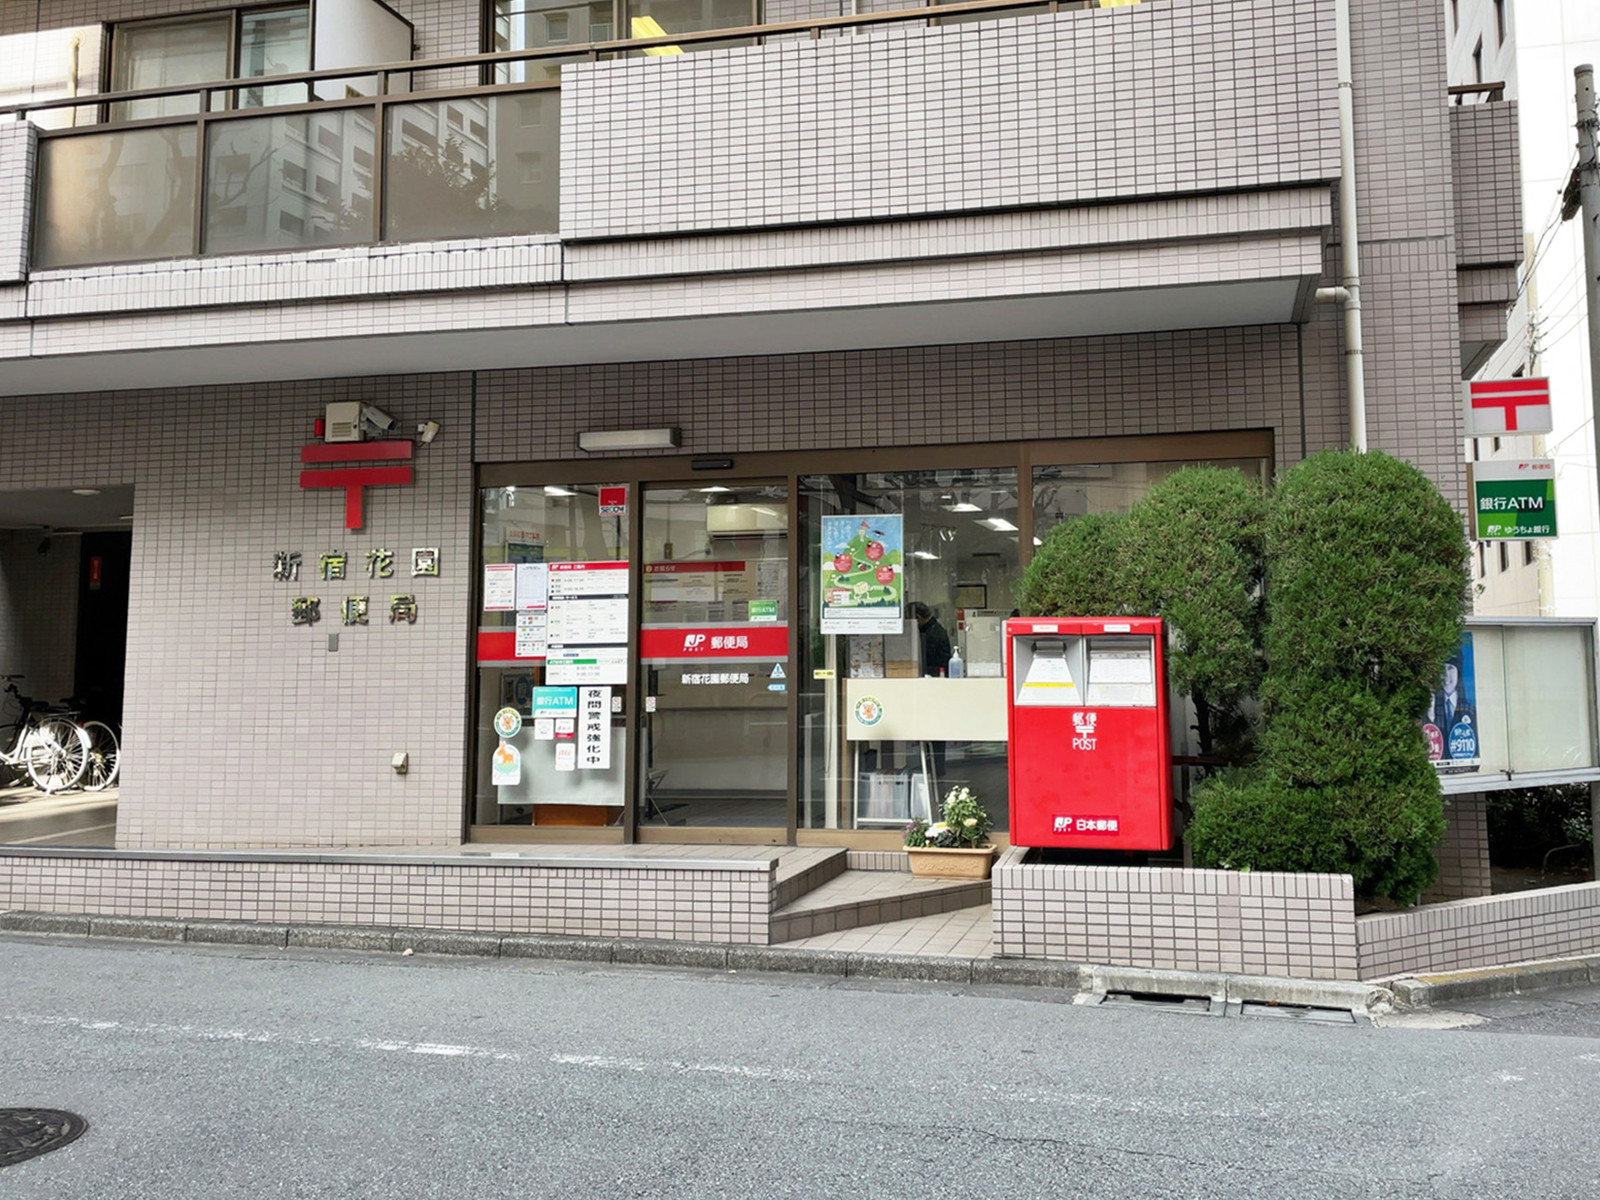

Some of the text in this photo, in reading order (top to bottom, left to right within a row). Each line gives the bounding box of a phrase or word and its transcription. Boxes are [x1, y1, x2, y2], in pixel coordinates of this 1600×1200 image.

[600, 506, 625, 514] SECOM
[1480, 496, 1543, 510] 銀行ATM
[1504, 525, 1550, 534] ゆうちょ銀行
[272, 548, 441, 581] 新宿花園
[291, 594, 418, 626] 郵便局
[710, 635, 749, 649] 郵便局
[681, 672, 750, 685] 新宿花園郵便局
[536, 695, 574, 706] 銀行ATM
[1072, 712, 1098, 727] 郵便
[586, 690, 602, 764] 夜間警戒強化中
[1072, 738, 1098, 751] POST
[1450, 738, 1475, 752] #9110
[1076, 818, 1119, 832] 日本郵便
